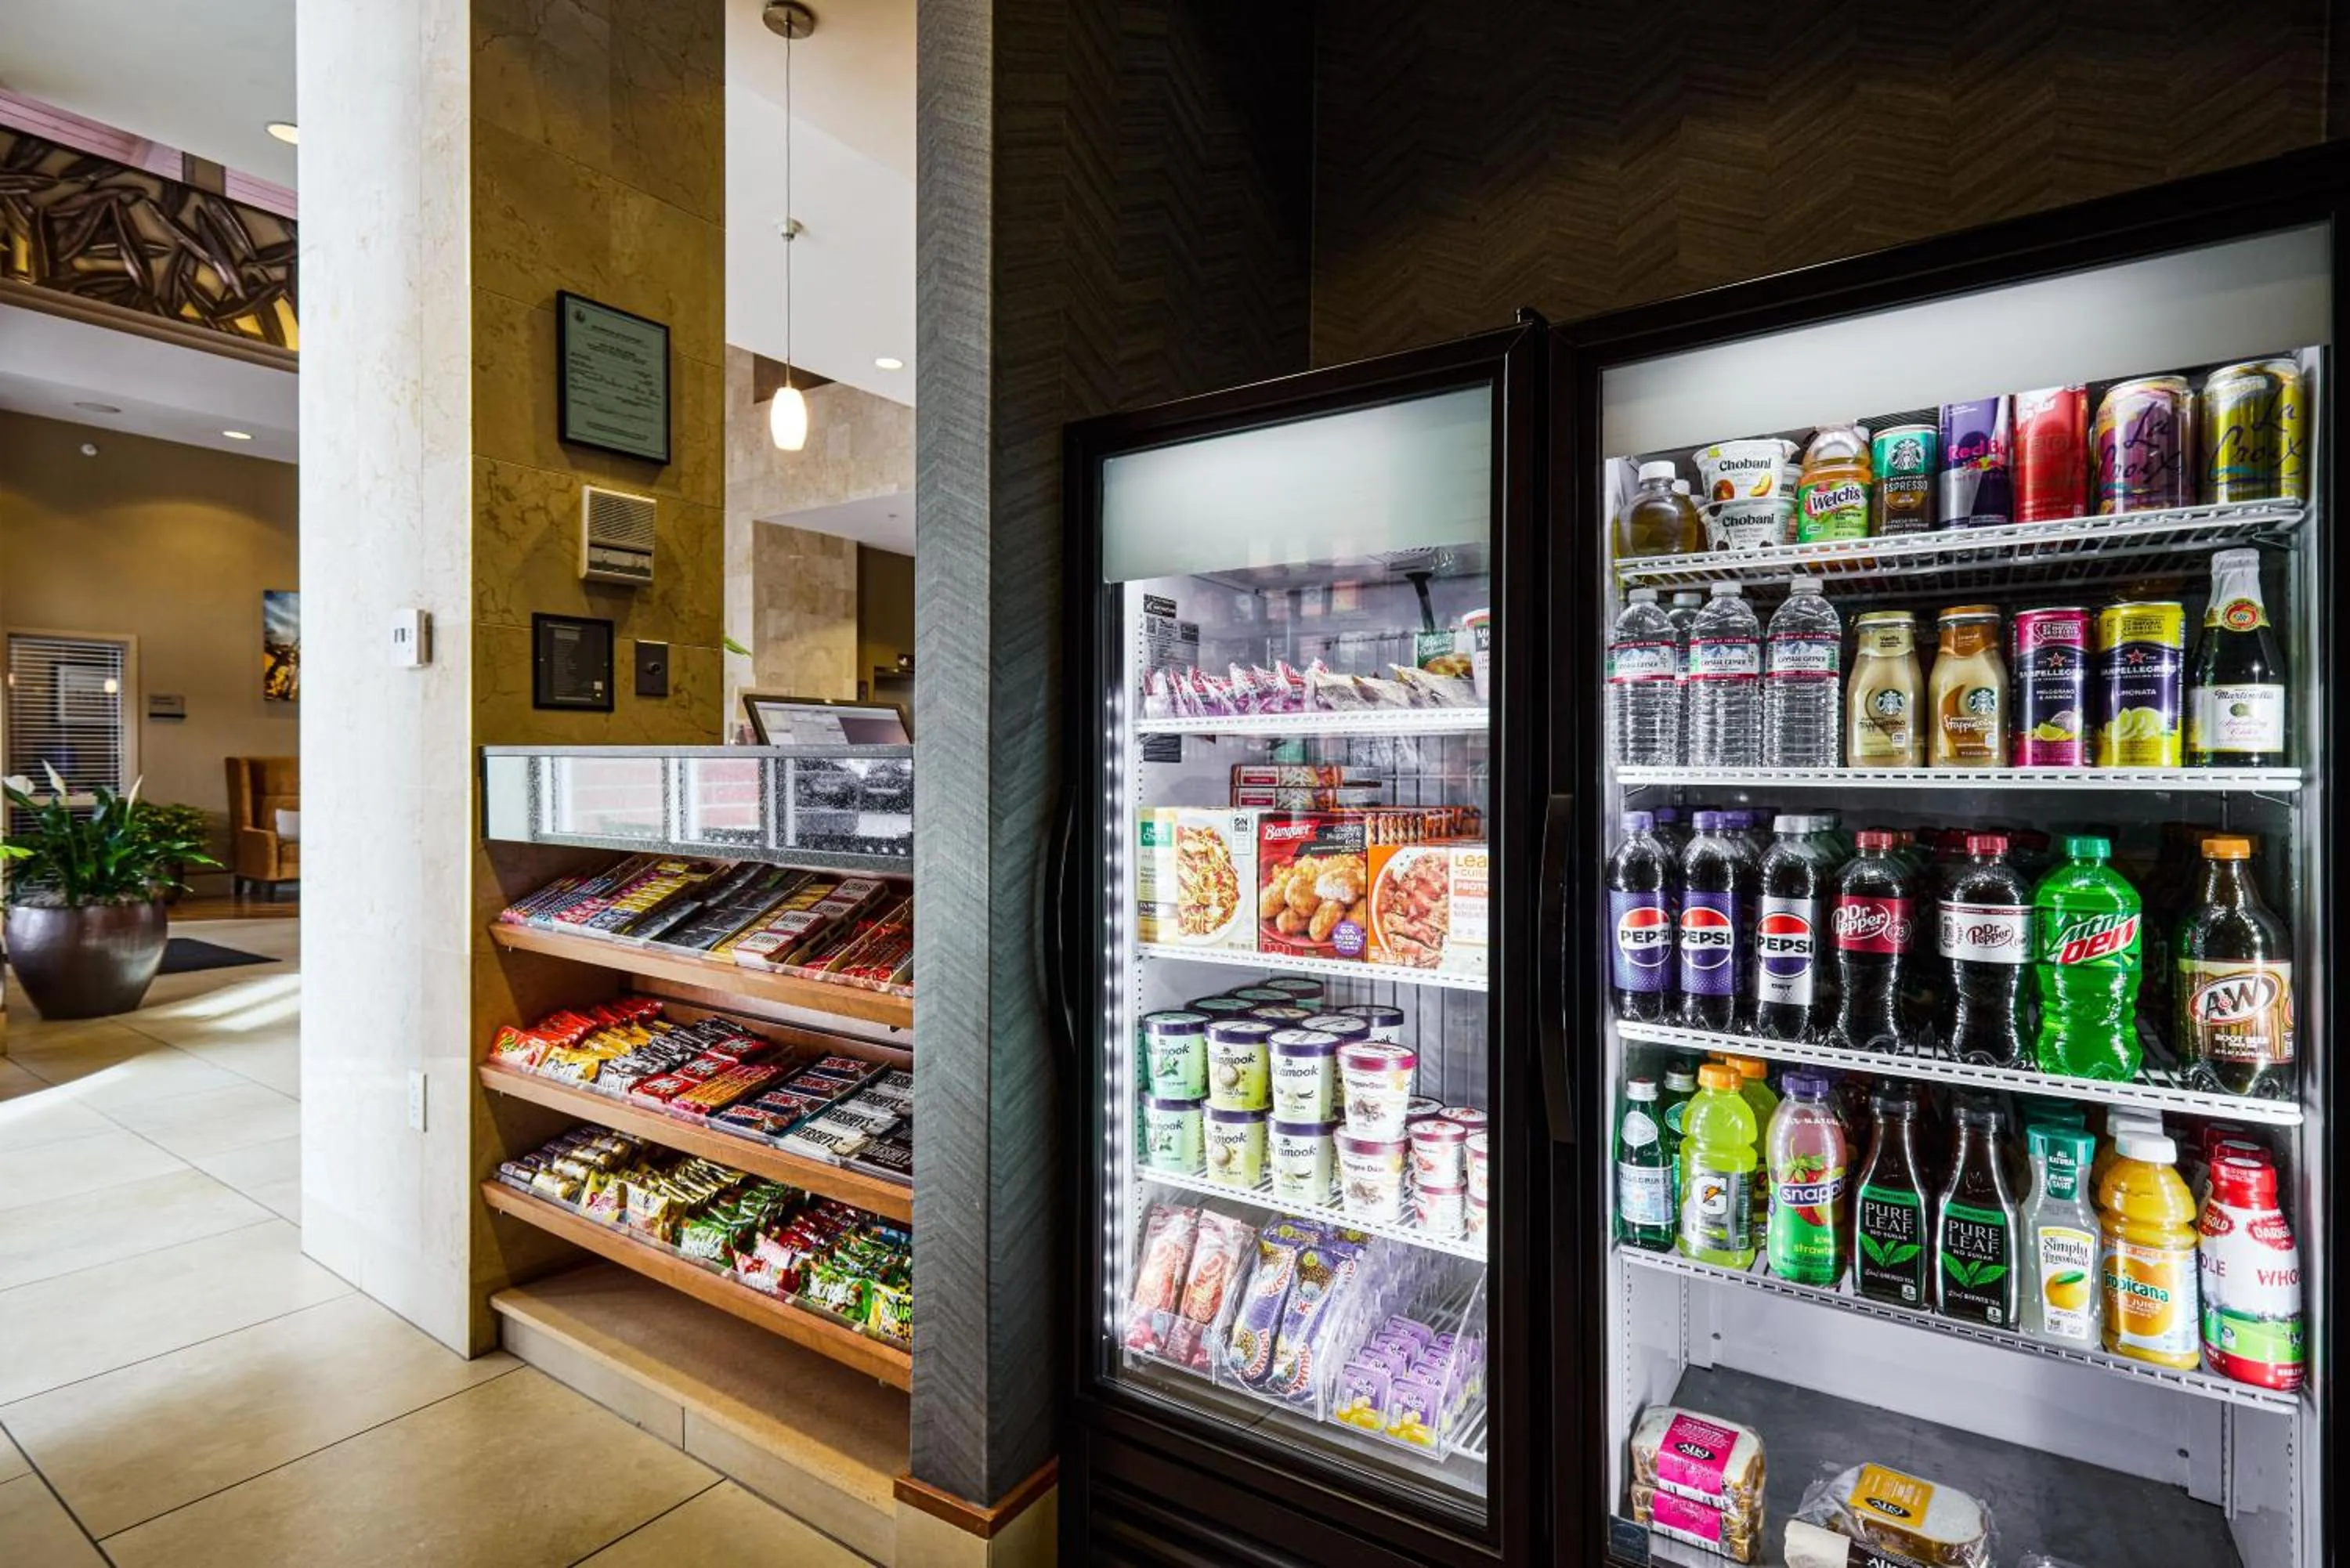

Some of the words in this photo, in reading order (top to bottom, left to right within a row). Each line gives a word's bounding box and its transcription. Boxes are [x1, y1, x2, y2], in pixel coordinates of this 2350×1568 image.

[1948, 439, 1984, 461] Red
[1719, 457, 1772, 471] Chobani
[1884, 480, 1928, 493] ESPRESSO
[1812, 486, 1861, 510] Welch's
[1723, 513, 1774, 527] Chobani
[1264, 823, 1314, 840] Banquet
[1849, 905, 1871, 920] Dr
[1835, 907, 1885, 936] Pepper
[1983, 923, 2001, 934] Dr
[1621, 929, 1671, 943] PEPSI
[1679, 929, 1731, 945] PEPSI
[1969, 926, 2010, 945] Pepper
[1757, 936, 1813, 954] PEPSI
[2204, 977, 2259, 1021] A&W
[2215, 1033, 2245, 1042] ROOT
[2048, 1155, 2077, 1166] NATURAL
[2056, 1150, 2068, 1158] ALL
[1865, 1201, 1913, 1222] PURE
[1865, 1213, 1914, 1234] LEAF
[1947, 1219, 2000, 1241] PURE
[1947, 1232, 2000, 1254] LEAF
[2043, 1237, 2088, 1259] Simply
[1968, 1252, 1994, 1262] SUGAR
[2104, 1269, 2170, 1302] Tropicana
